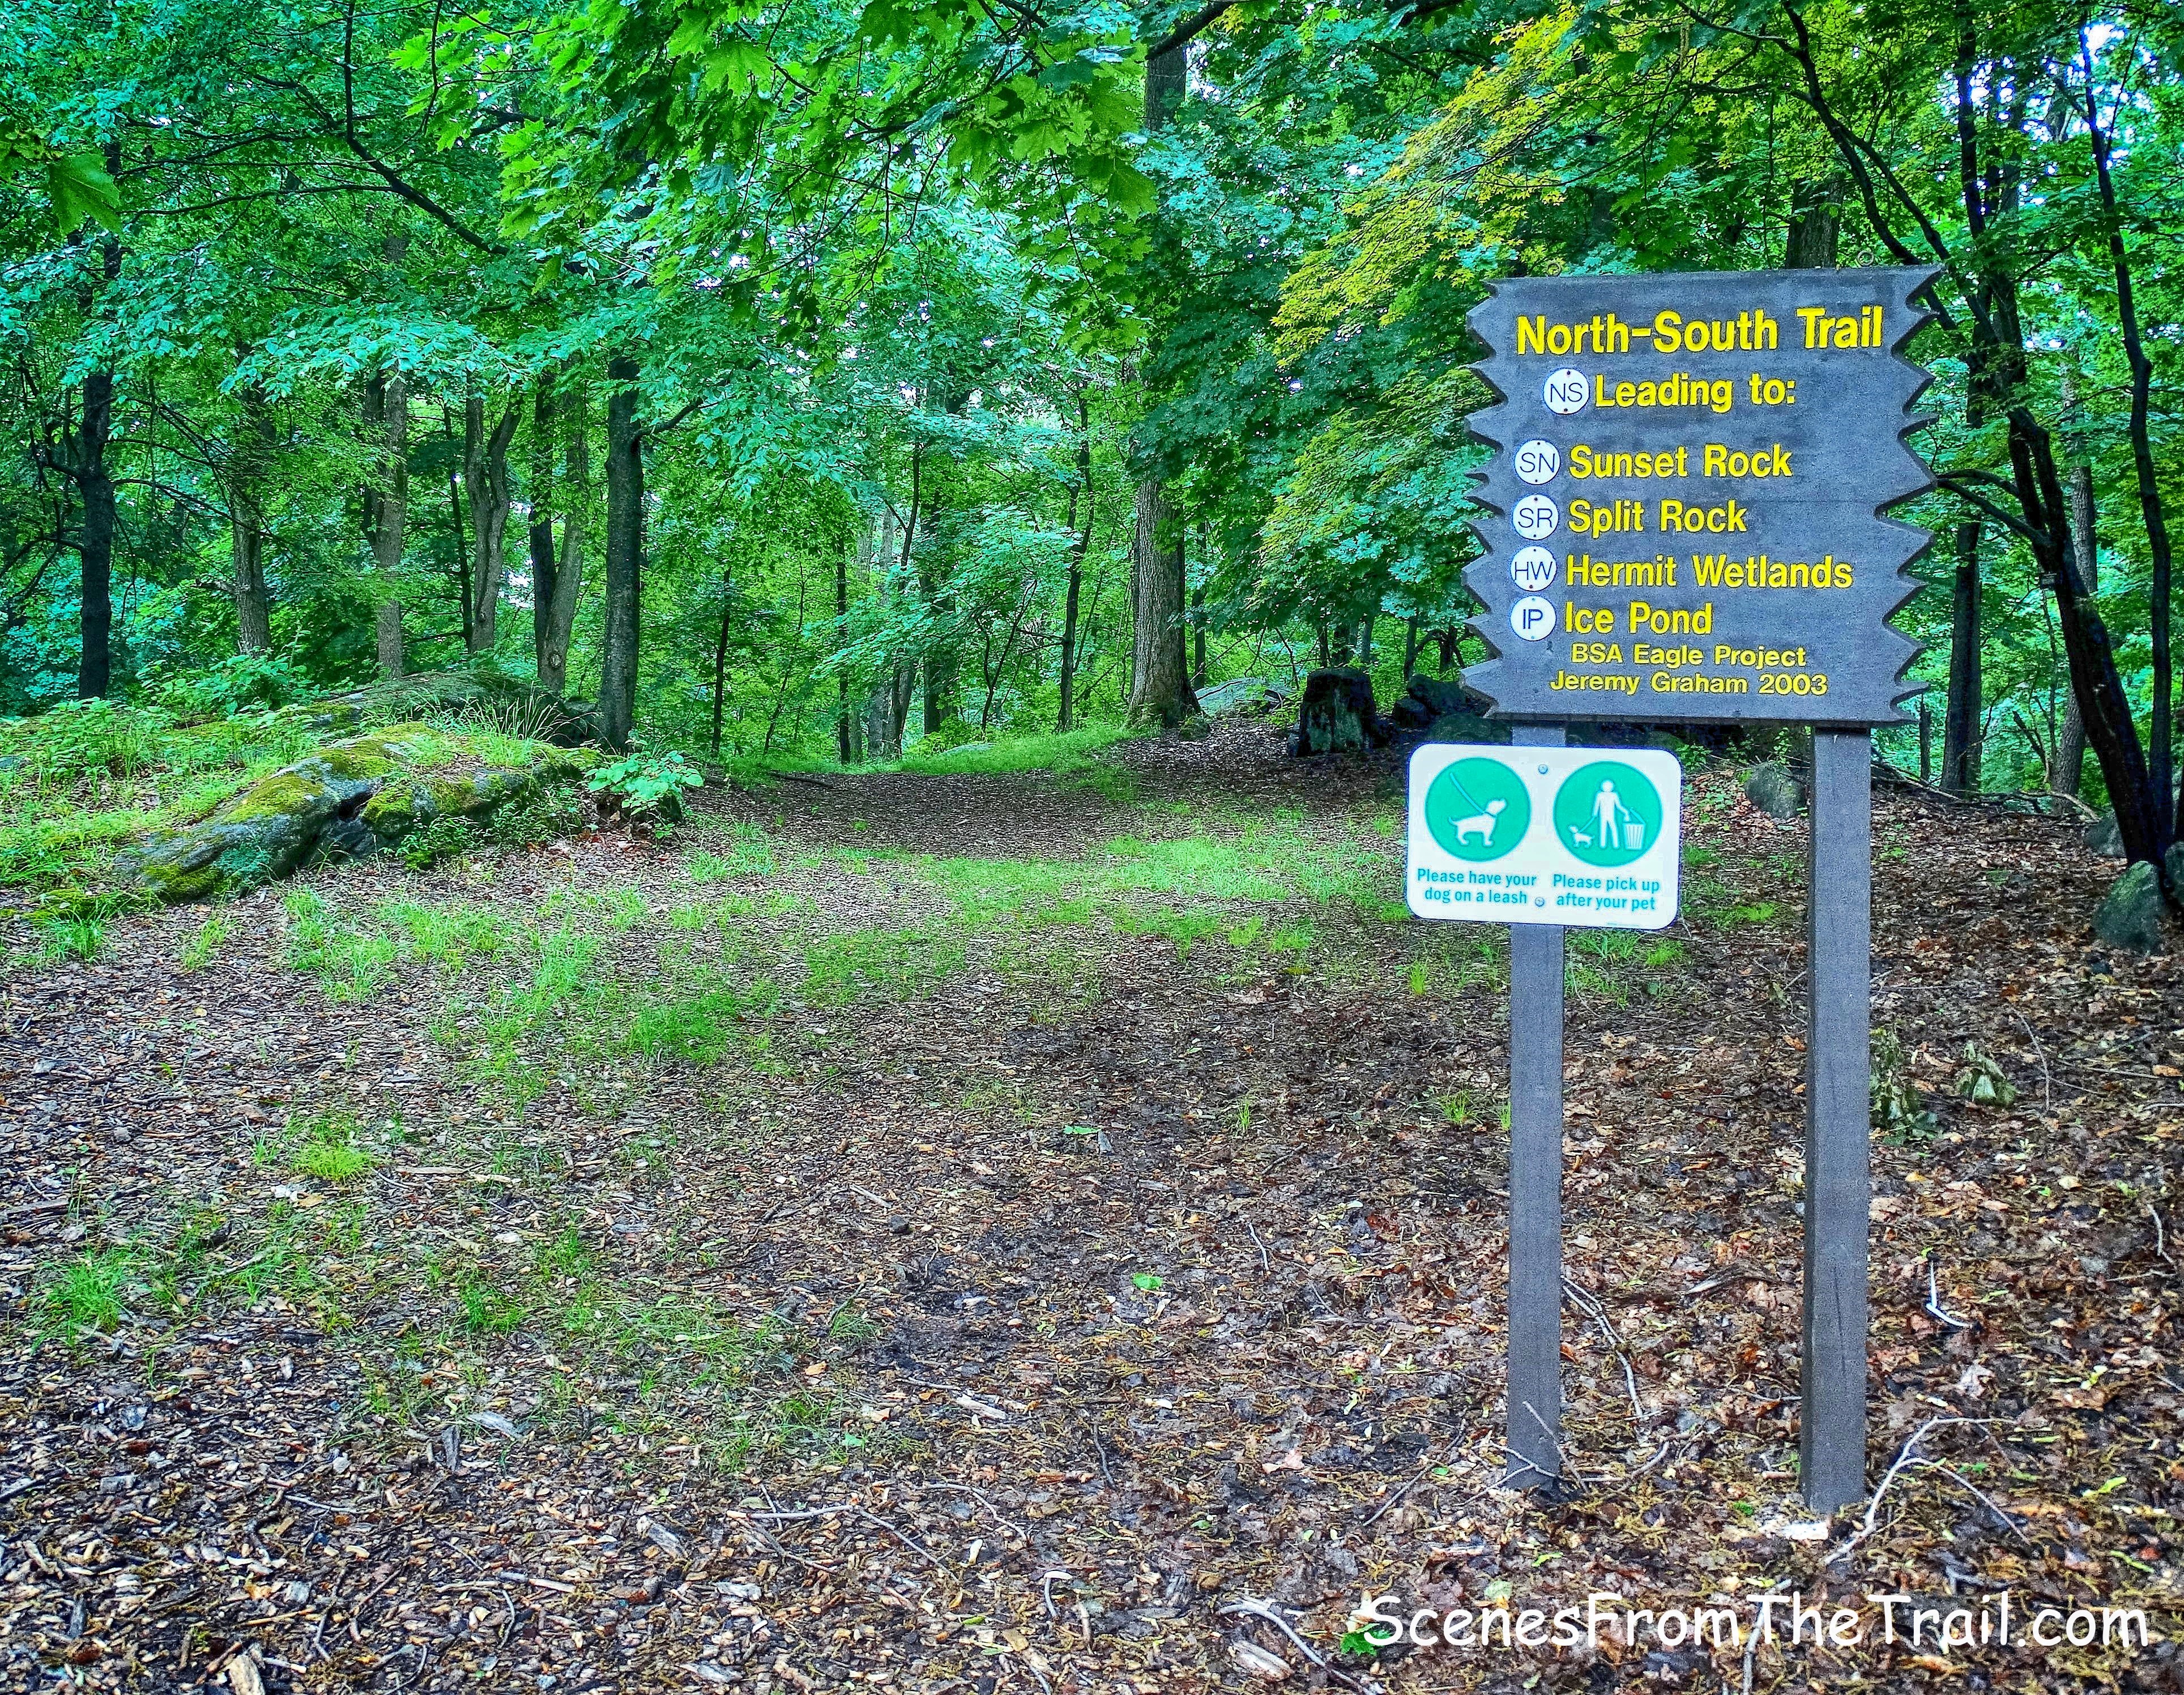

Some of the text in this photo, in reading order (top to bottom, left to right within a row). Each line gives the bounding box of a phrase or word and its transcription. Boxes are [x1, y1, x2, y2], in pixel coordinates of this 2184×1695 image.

[1517, 305, 1884, 355] North-South Trail
[1549, 383, 1582, 402] NS
[1595, 373, 1796, 413] Leading to:
[1520, 453, 1555, 473] SN
[1569, 443, 1793, 479] Sunset Rock
[1518, 507, 1553, 528] SR
[1568, 499, 1748, 539] Split Rock
[1515, 561, 1554, 581] HW
[1566, 554, 1854, 589] Hermit Wetlands
[1522, 609, 1542, 629] IP
[1565, 602, 1713, 635] Ice Pond
[1571, 644, 1806, 669] BSA Eagle Project
[1550, 671, 1827, 695] Jeremy Graham 2003
[1417, 869, 1537, 887] Please have your
[1553, 874, 1660, 894] Please pick up
[1425, 887, 1527, 903] dog on a leash
[1556, 894, 1656, 911] after your pet
